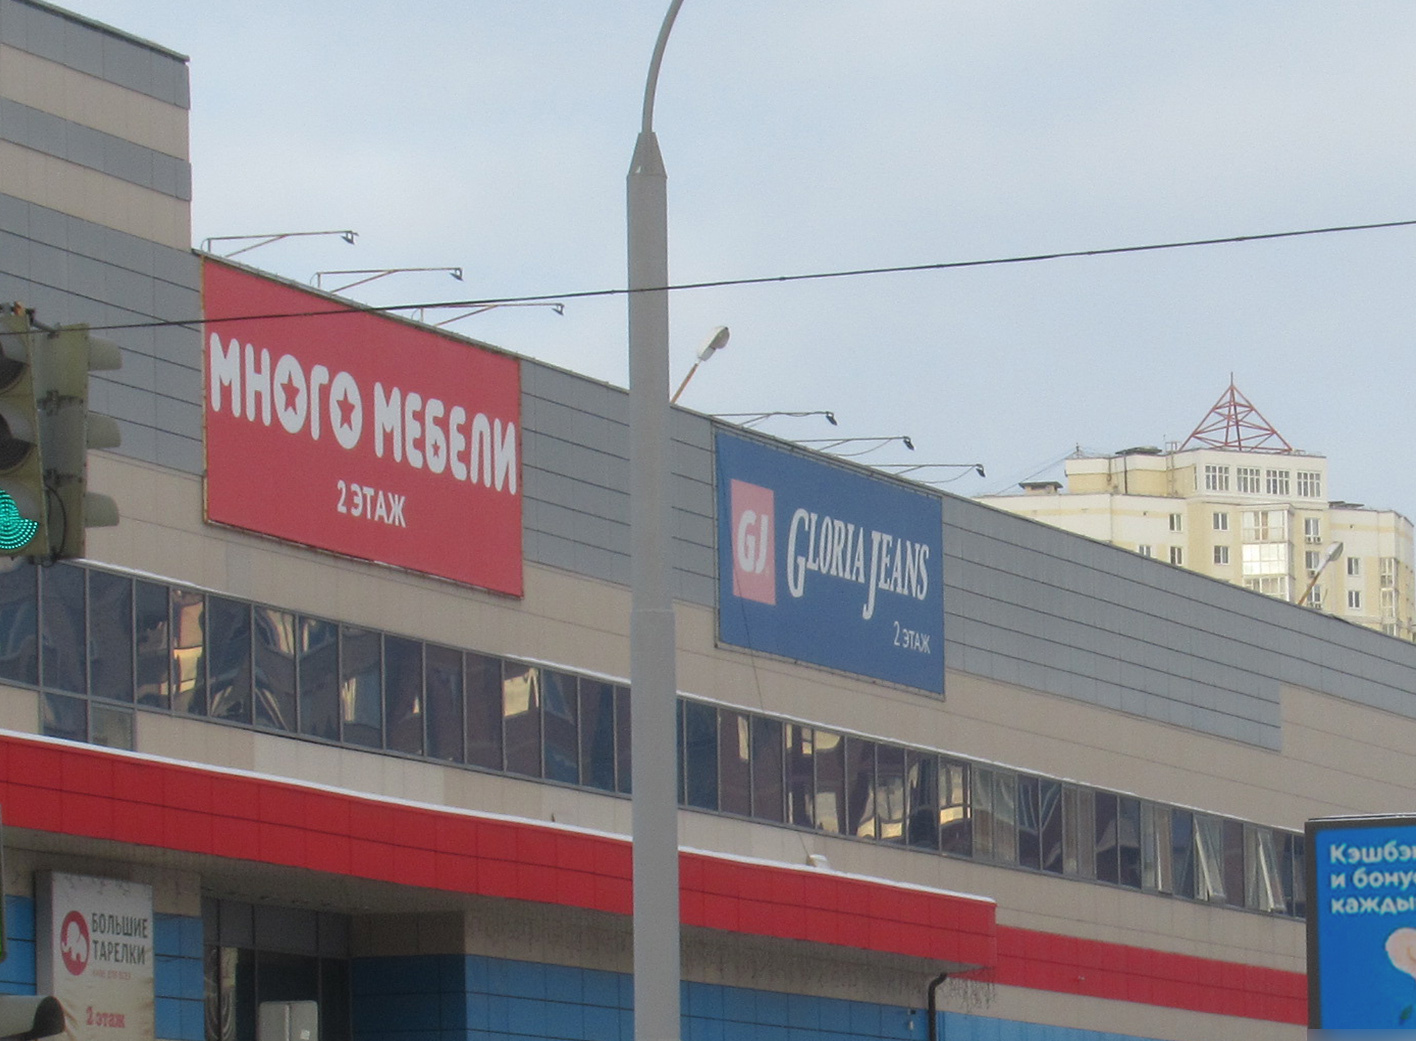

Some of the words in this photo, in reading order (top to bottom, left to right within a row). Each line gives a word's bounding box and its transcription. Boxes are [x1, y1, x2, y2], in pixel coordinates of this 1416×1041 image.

[209, 331, 364, 450] МНОГО
[373, 381, 518, 496] МЕБЕЛИ
[337, 479, 348, 514] 2
[351, 485, 406, 528] ЭТАЖ
[737, 509, 769, 574] GJ
[786, 507, 866, 598] GLORIA
[862, 530, 930, 621] JEANS
[893, 620, 901, 647] 2
[902, 628, 931, 655] ЭТАЖ
[1330, 872, 1347, 890] и
[91, 912, 148, 939] БОЛЬШИЕ
[92, 939, 146, 965] ТАРЕЛКИ
[86, 1005, 94, 1026] 2
[96, 1011, 126, 1029] этаж
